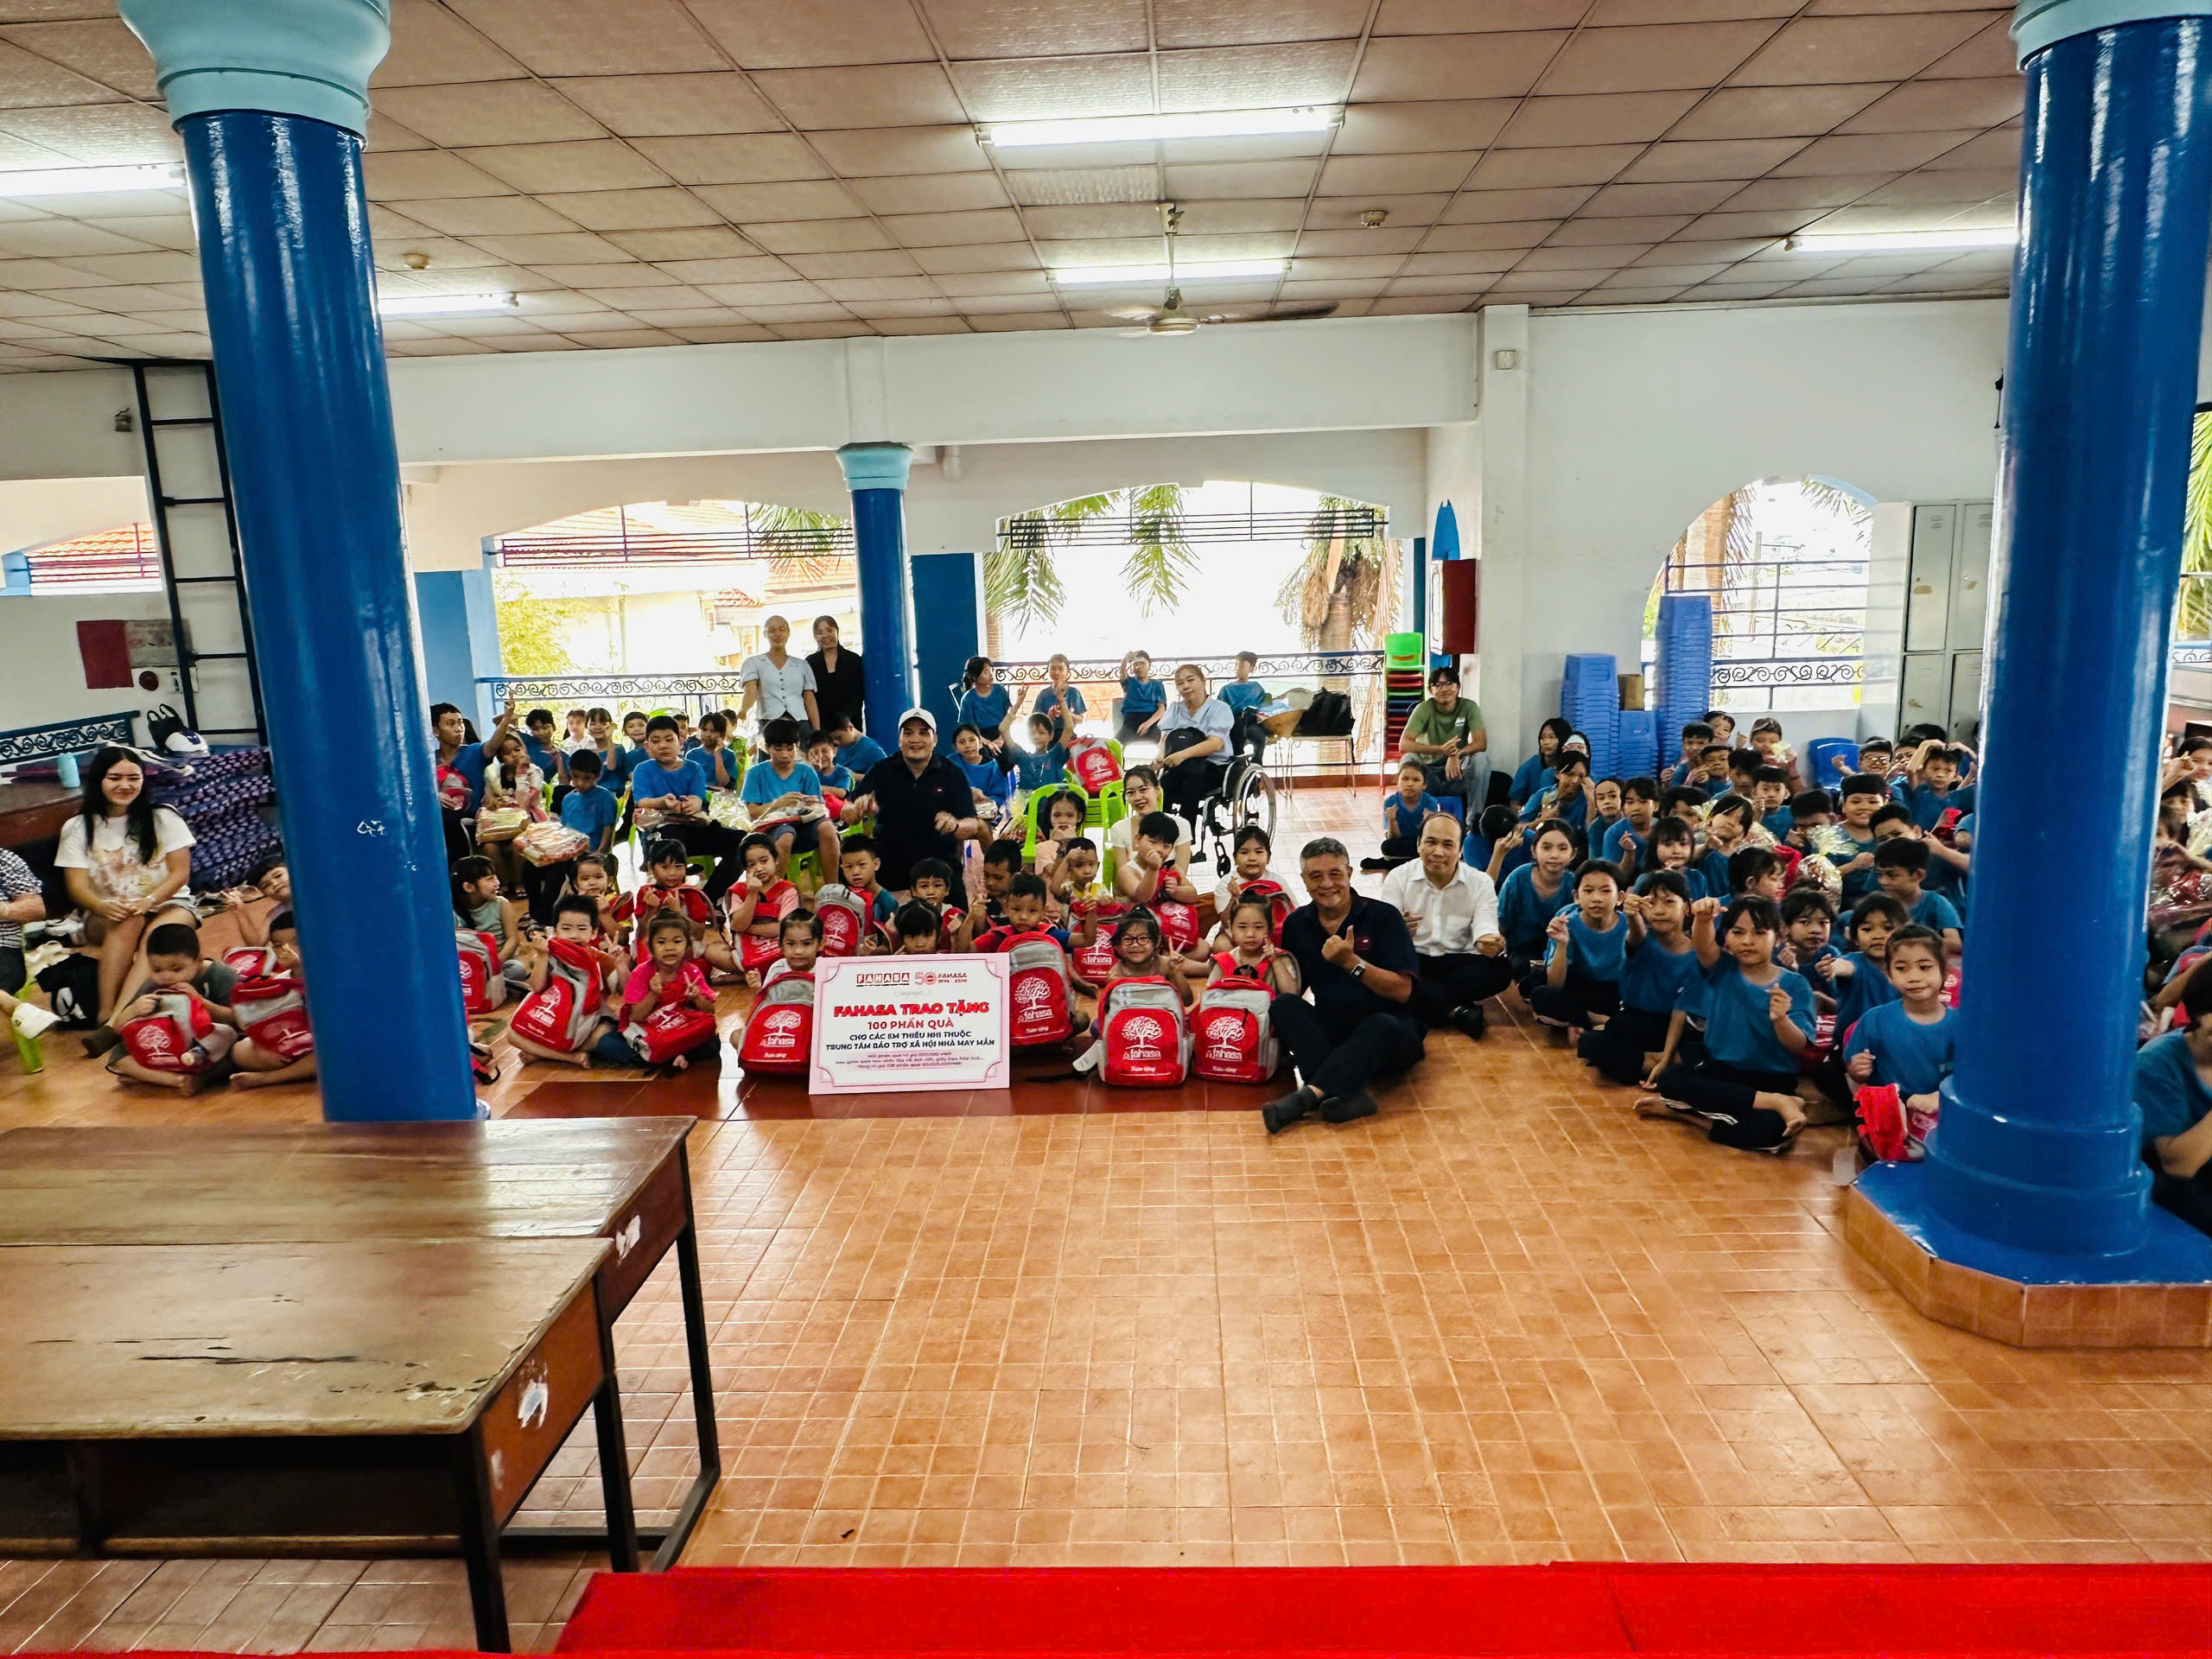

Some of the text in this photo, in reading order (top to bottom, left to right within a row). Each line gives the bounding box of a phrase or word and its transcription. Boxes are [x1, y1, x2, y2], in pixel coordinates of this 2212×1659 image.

[856, 973, 910, 983] FAHASA
[834, 999, 989, 1017] FAHASA TRAO TẶNG
[868, 1020, 887, 1030] 100
[928, 1017, 954, 1029] QUÀ
[944, 1030, 972, 1039] THUỘC
[910, 1039, 920, 1048] XÃ
[922, 1039, 937, 1048] HỘI
